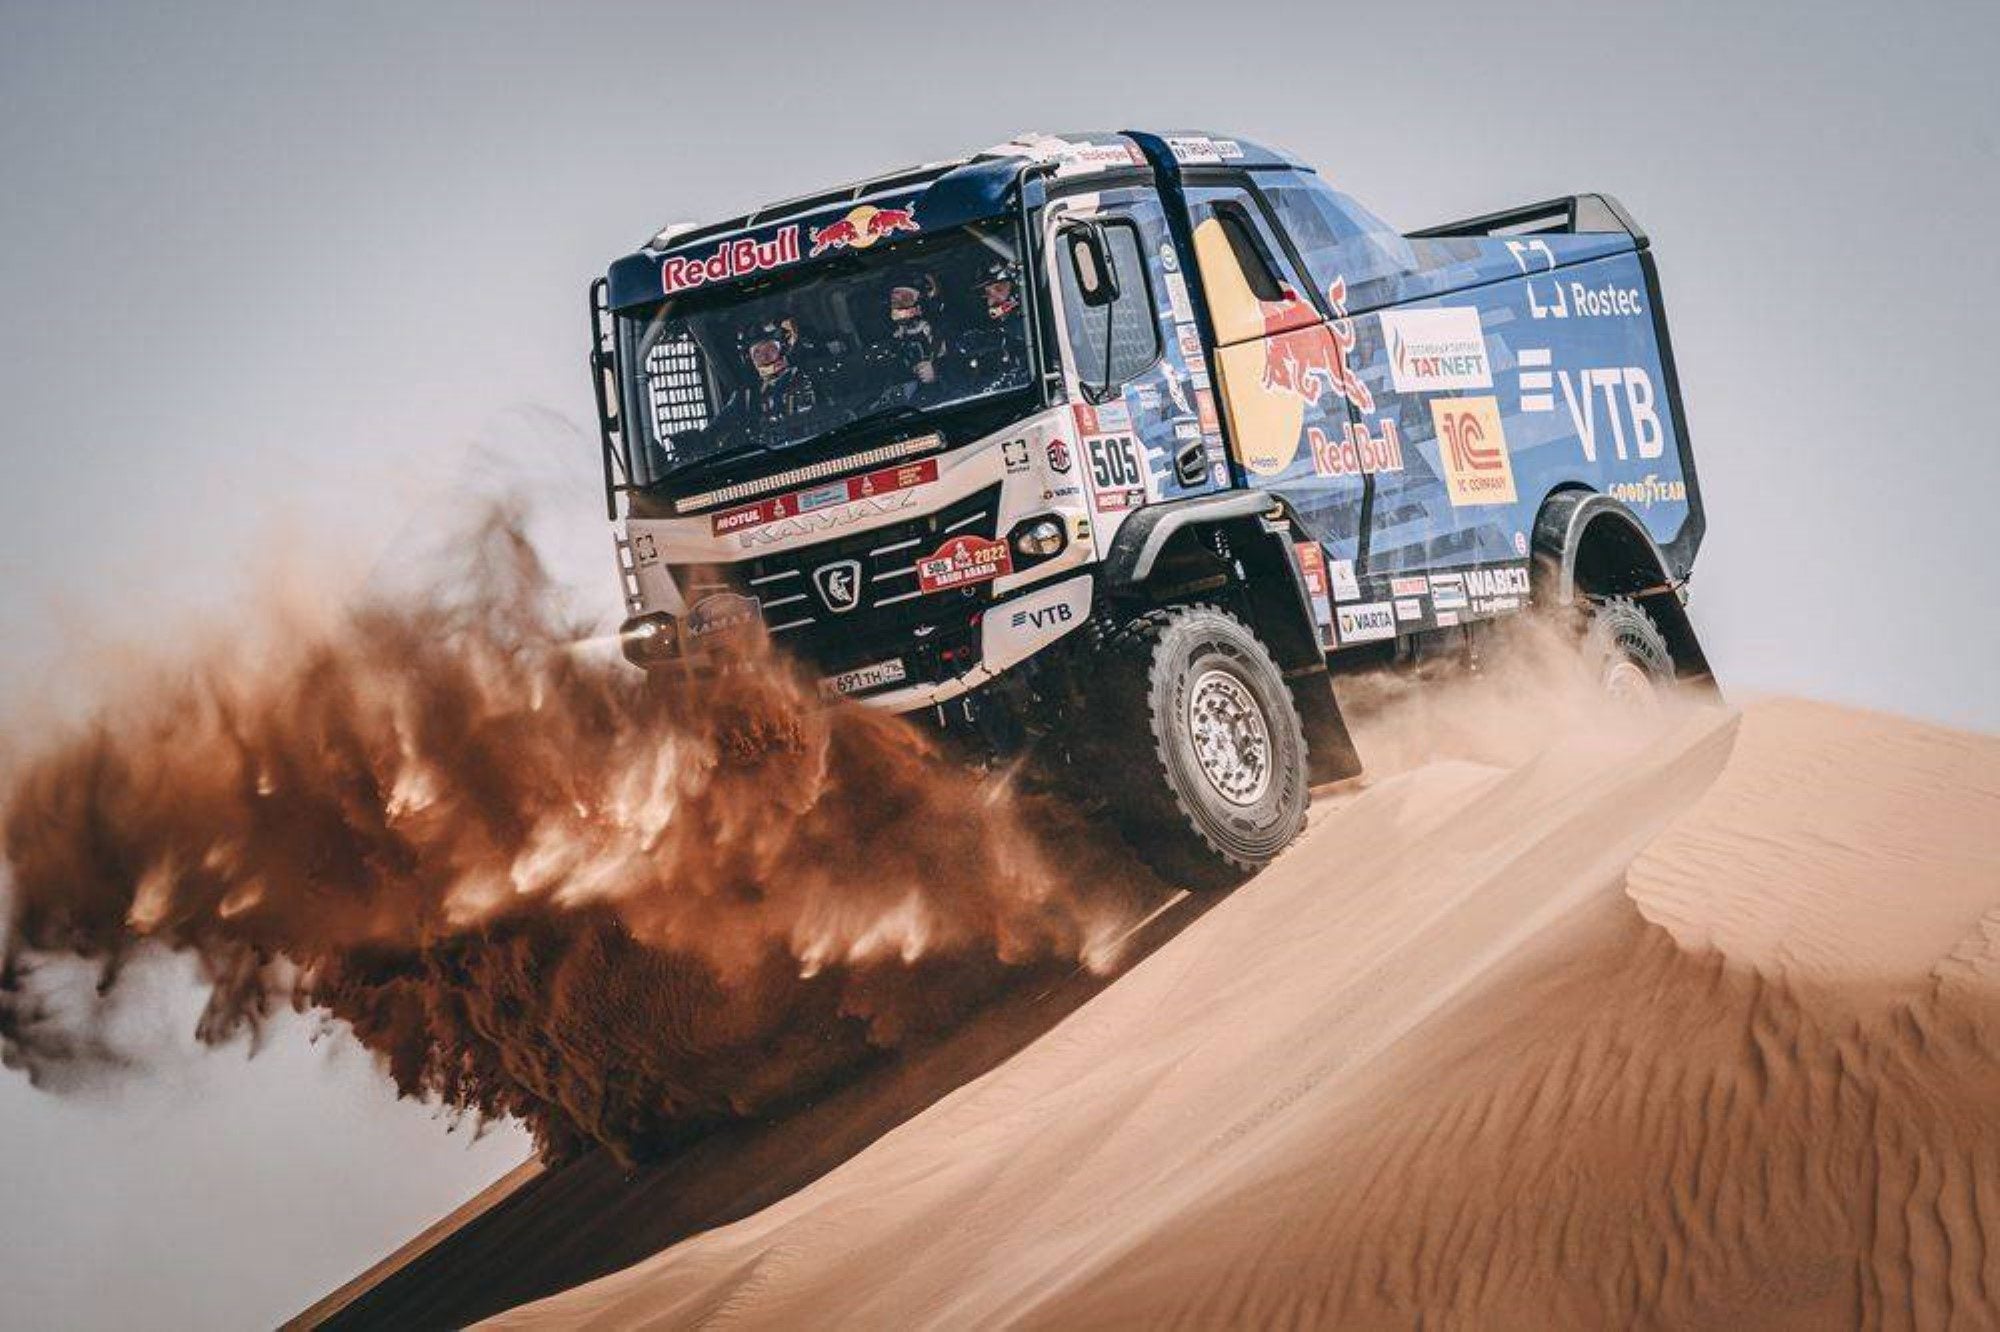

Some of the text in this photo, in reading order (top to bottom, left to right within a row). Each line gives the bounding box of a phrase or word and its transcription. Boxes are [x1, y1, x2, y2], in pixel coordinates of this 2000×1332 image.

[1570, 283, 1643, 317] Rostec
[1410, 355, 1482, 377] TATNEFT
[1558, 367, 1664, 462] VTB
[1088, 437, 1140, 488] 505
[717, 510, 761, 531] MOTUL
[974, 546, 1007, 565] 2022
[1465, 567, 1530, 596] WABCO
[1029, 603, 1072, 629] VTB
[1355, 611, 1393, 630] VARTA
